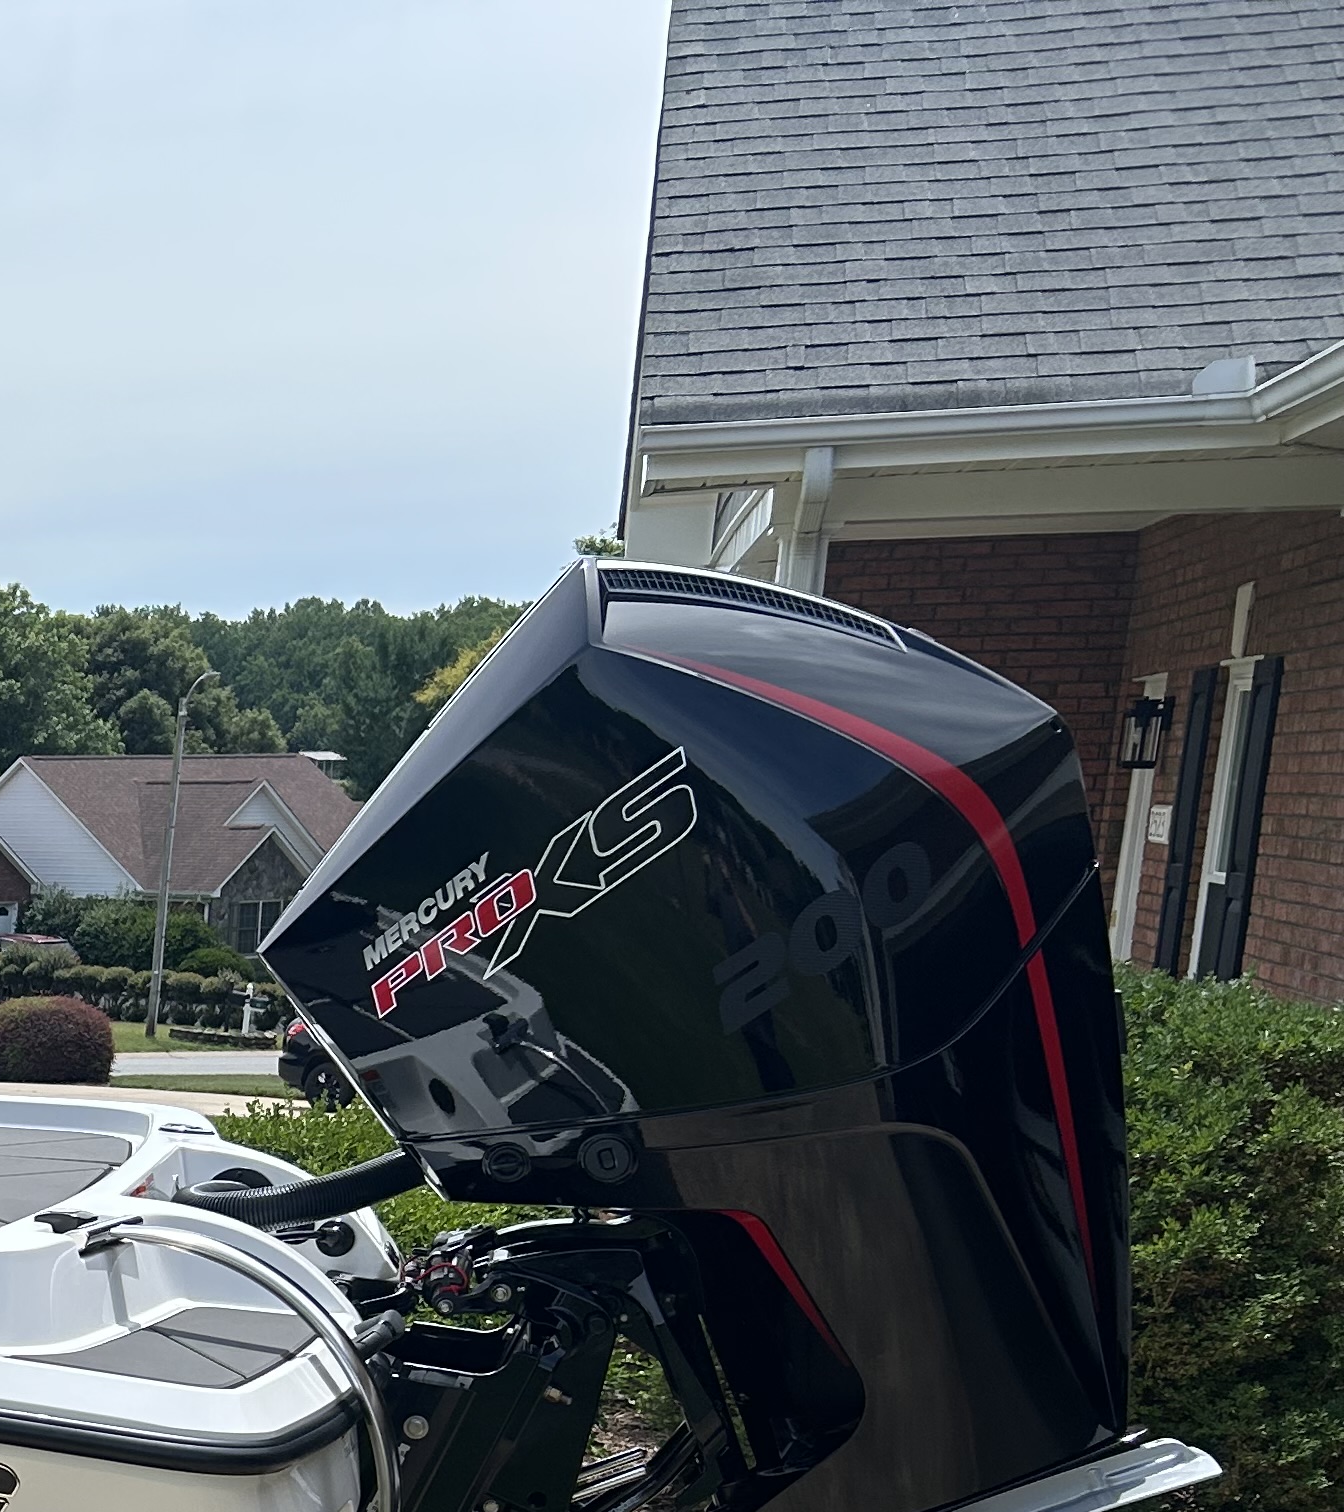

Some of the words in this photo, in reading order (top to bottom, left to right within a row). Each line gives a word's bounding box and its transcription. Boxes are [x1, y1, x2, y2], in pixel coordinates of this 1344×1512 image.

[363, 851, 489, 970] MERCURY
[371, 868, 537, 1019] PRO
[469, 746, 698, 980] XS
[712, 841, 930, 1035] 200
